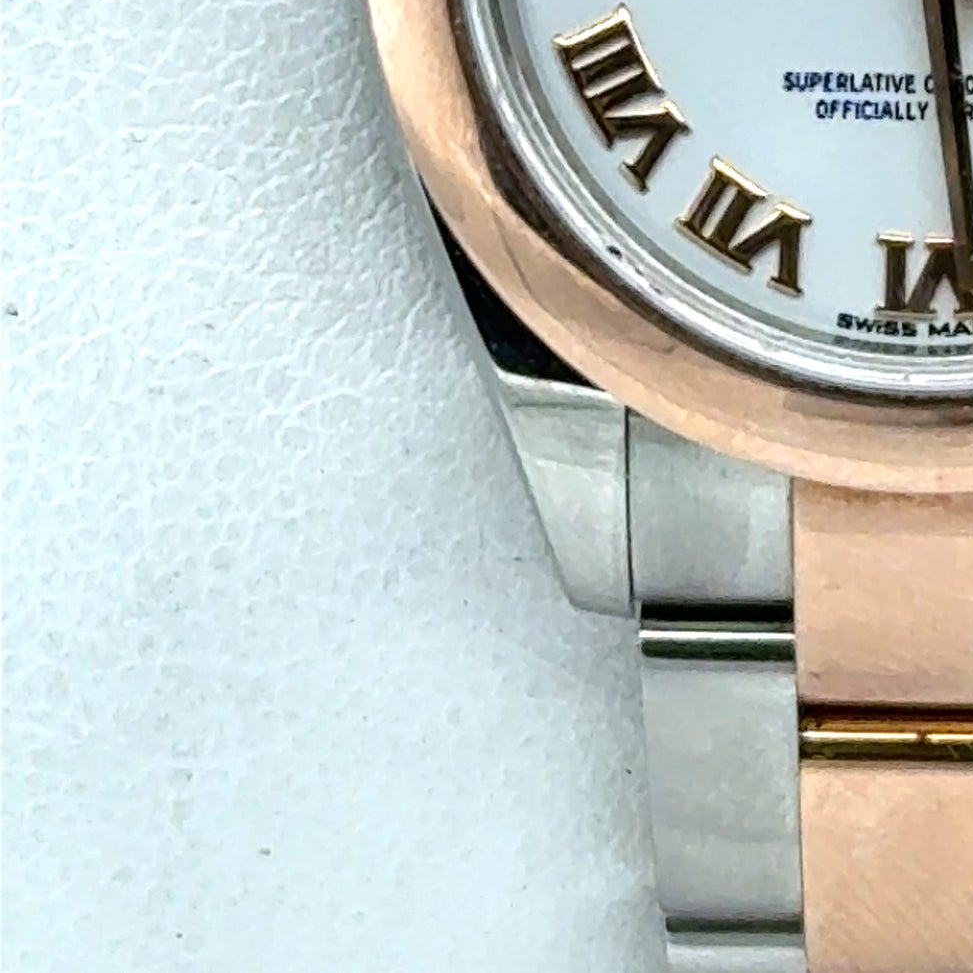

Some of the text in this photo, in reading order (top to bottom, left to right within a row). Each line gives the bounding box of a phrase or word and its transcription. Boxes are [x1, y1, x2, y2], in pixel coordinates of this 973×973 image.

[782, 71, 915, 94] SUPERLATIVE
[815, 99, 928, 121] OFFICIALLY
[836, 313, 918, 337] SWISS
